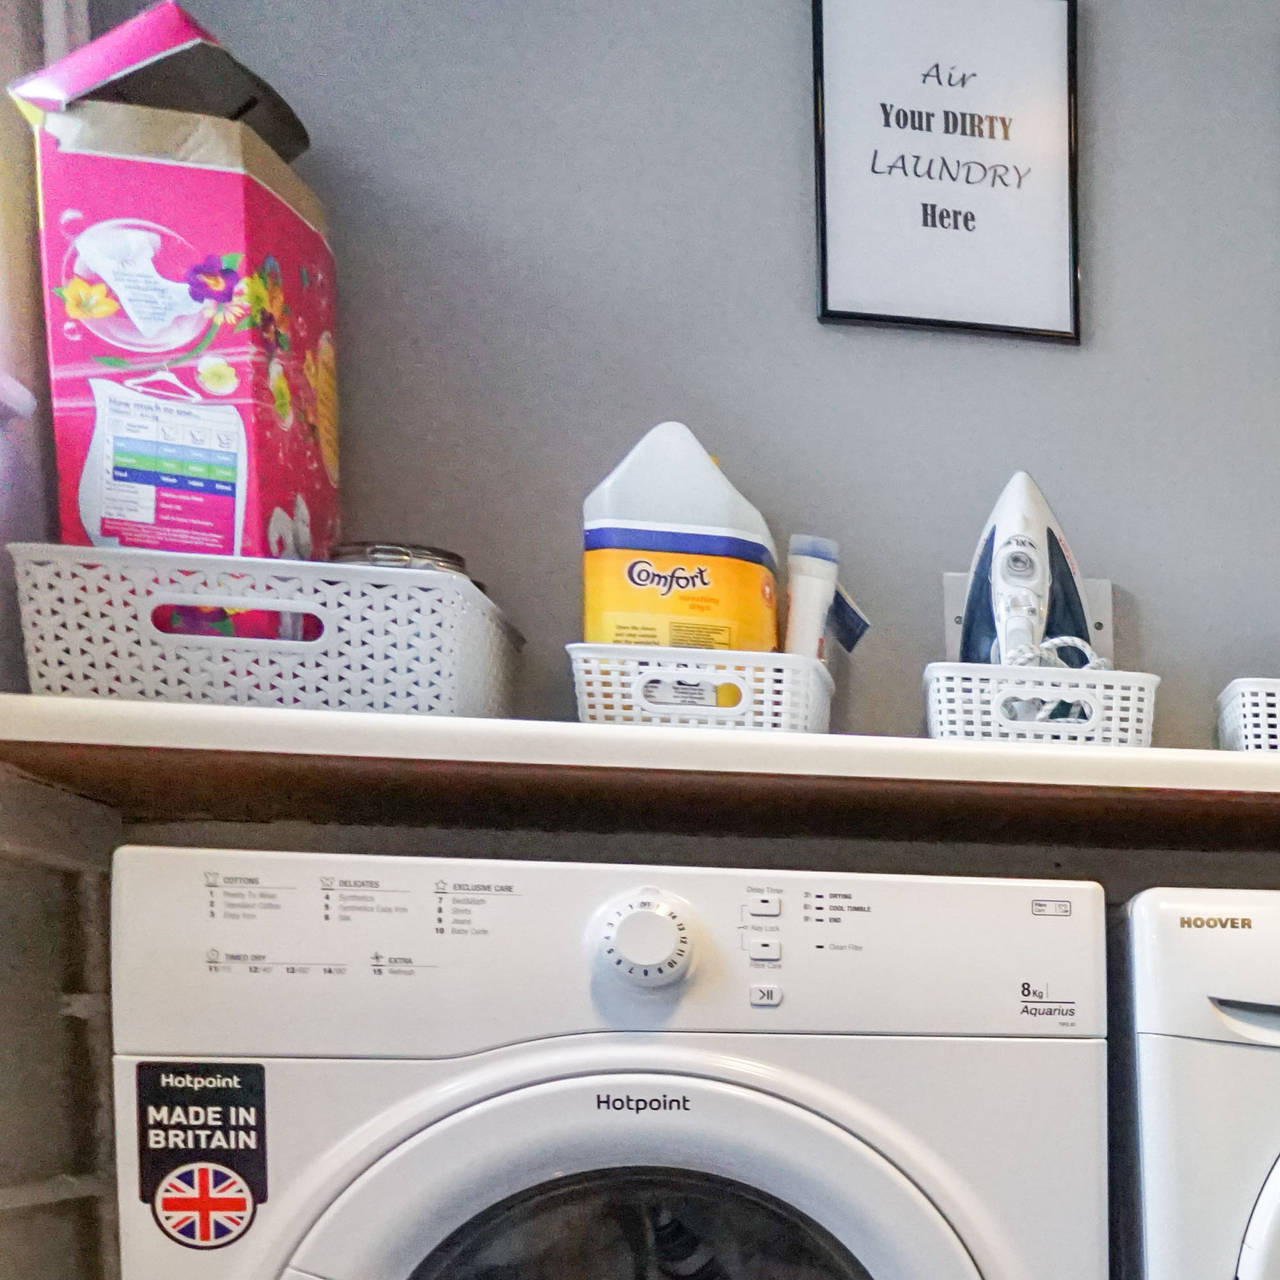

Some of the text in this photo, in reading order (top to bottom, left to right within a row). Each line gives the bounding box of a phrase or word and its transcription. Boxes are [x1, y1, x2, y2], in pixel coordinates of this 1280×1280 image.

[921, 62, 978, 88] Air
[880, 102, 1013, 141] Your DIRTY
[871, 149, 1031, 189] LAUNDRY
[921, 203, 976, 232] Here
[628, 560, 710, 596] Comfort
[1180, 916, 1252, 929] HOOVER
[1020, 1005, 1076, 1017] Aquarius
[161, 1073, 242, 1091] Hotpoint
[596, 1094, 691, 1114] Hotpoint
[147, 1106, 256, 1126] MADE IN
[148, 1129, 258, 1149] BRITAIN
